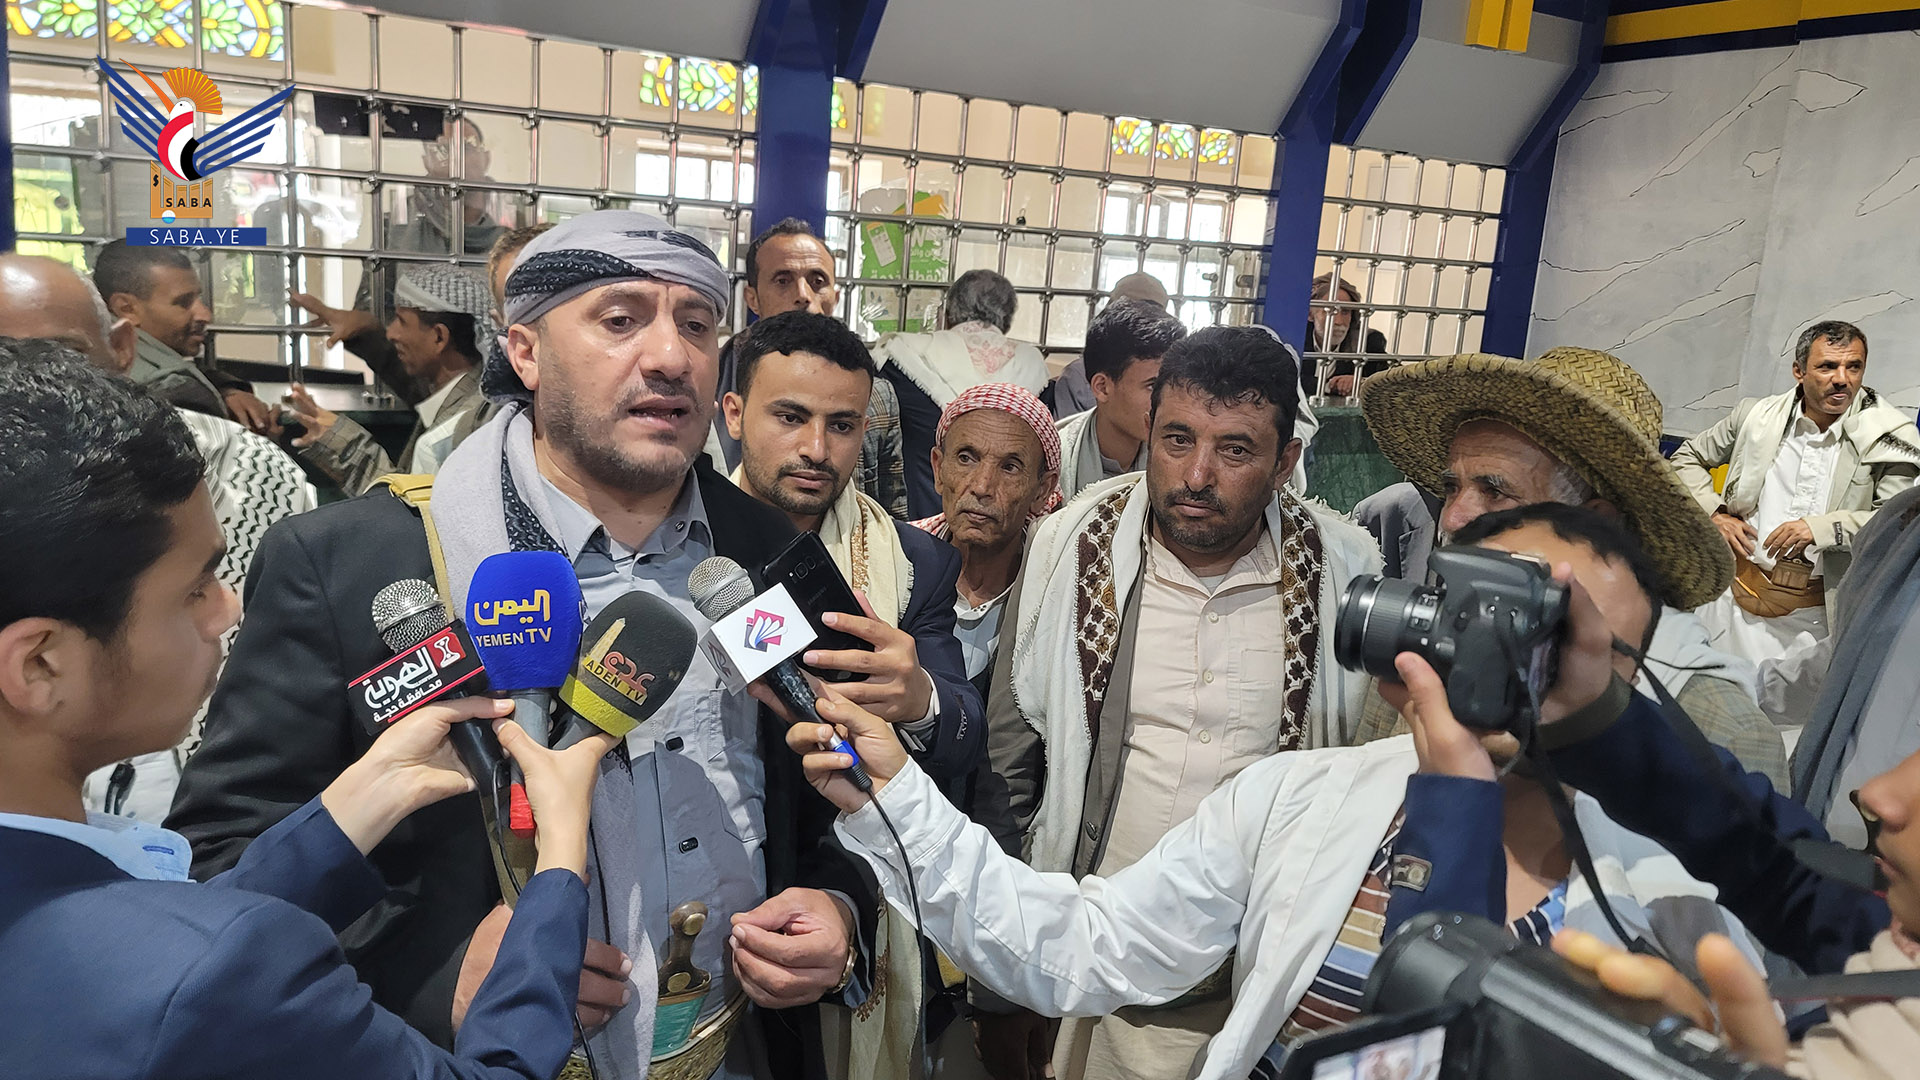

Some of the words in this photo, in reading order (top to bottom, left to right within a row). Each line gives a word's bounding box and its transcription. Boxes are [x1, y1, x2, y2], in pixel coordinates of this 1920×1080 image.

[474, 589, 550, 625] اليمن
[475, 632, 524, 647] YEMEN
[525, 627, 552, 643] TV
[364, 646, 438, 709] الهوية
[397, 678, 443, 709] محافظة
[586, 660, 622, 688] ADEN
[626, 686, 643, 701] TV
[373, 705, 400, 722] حجة
